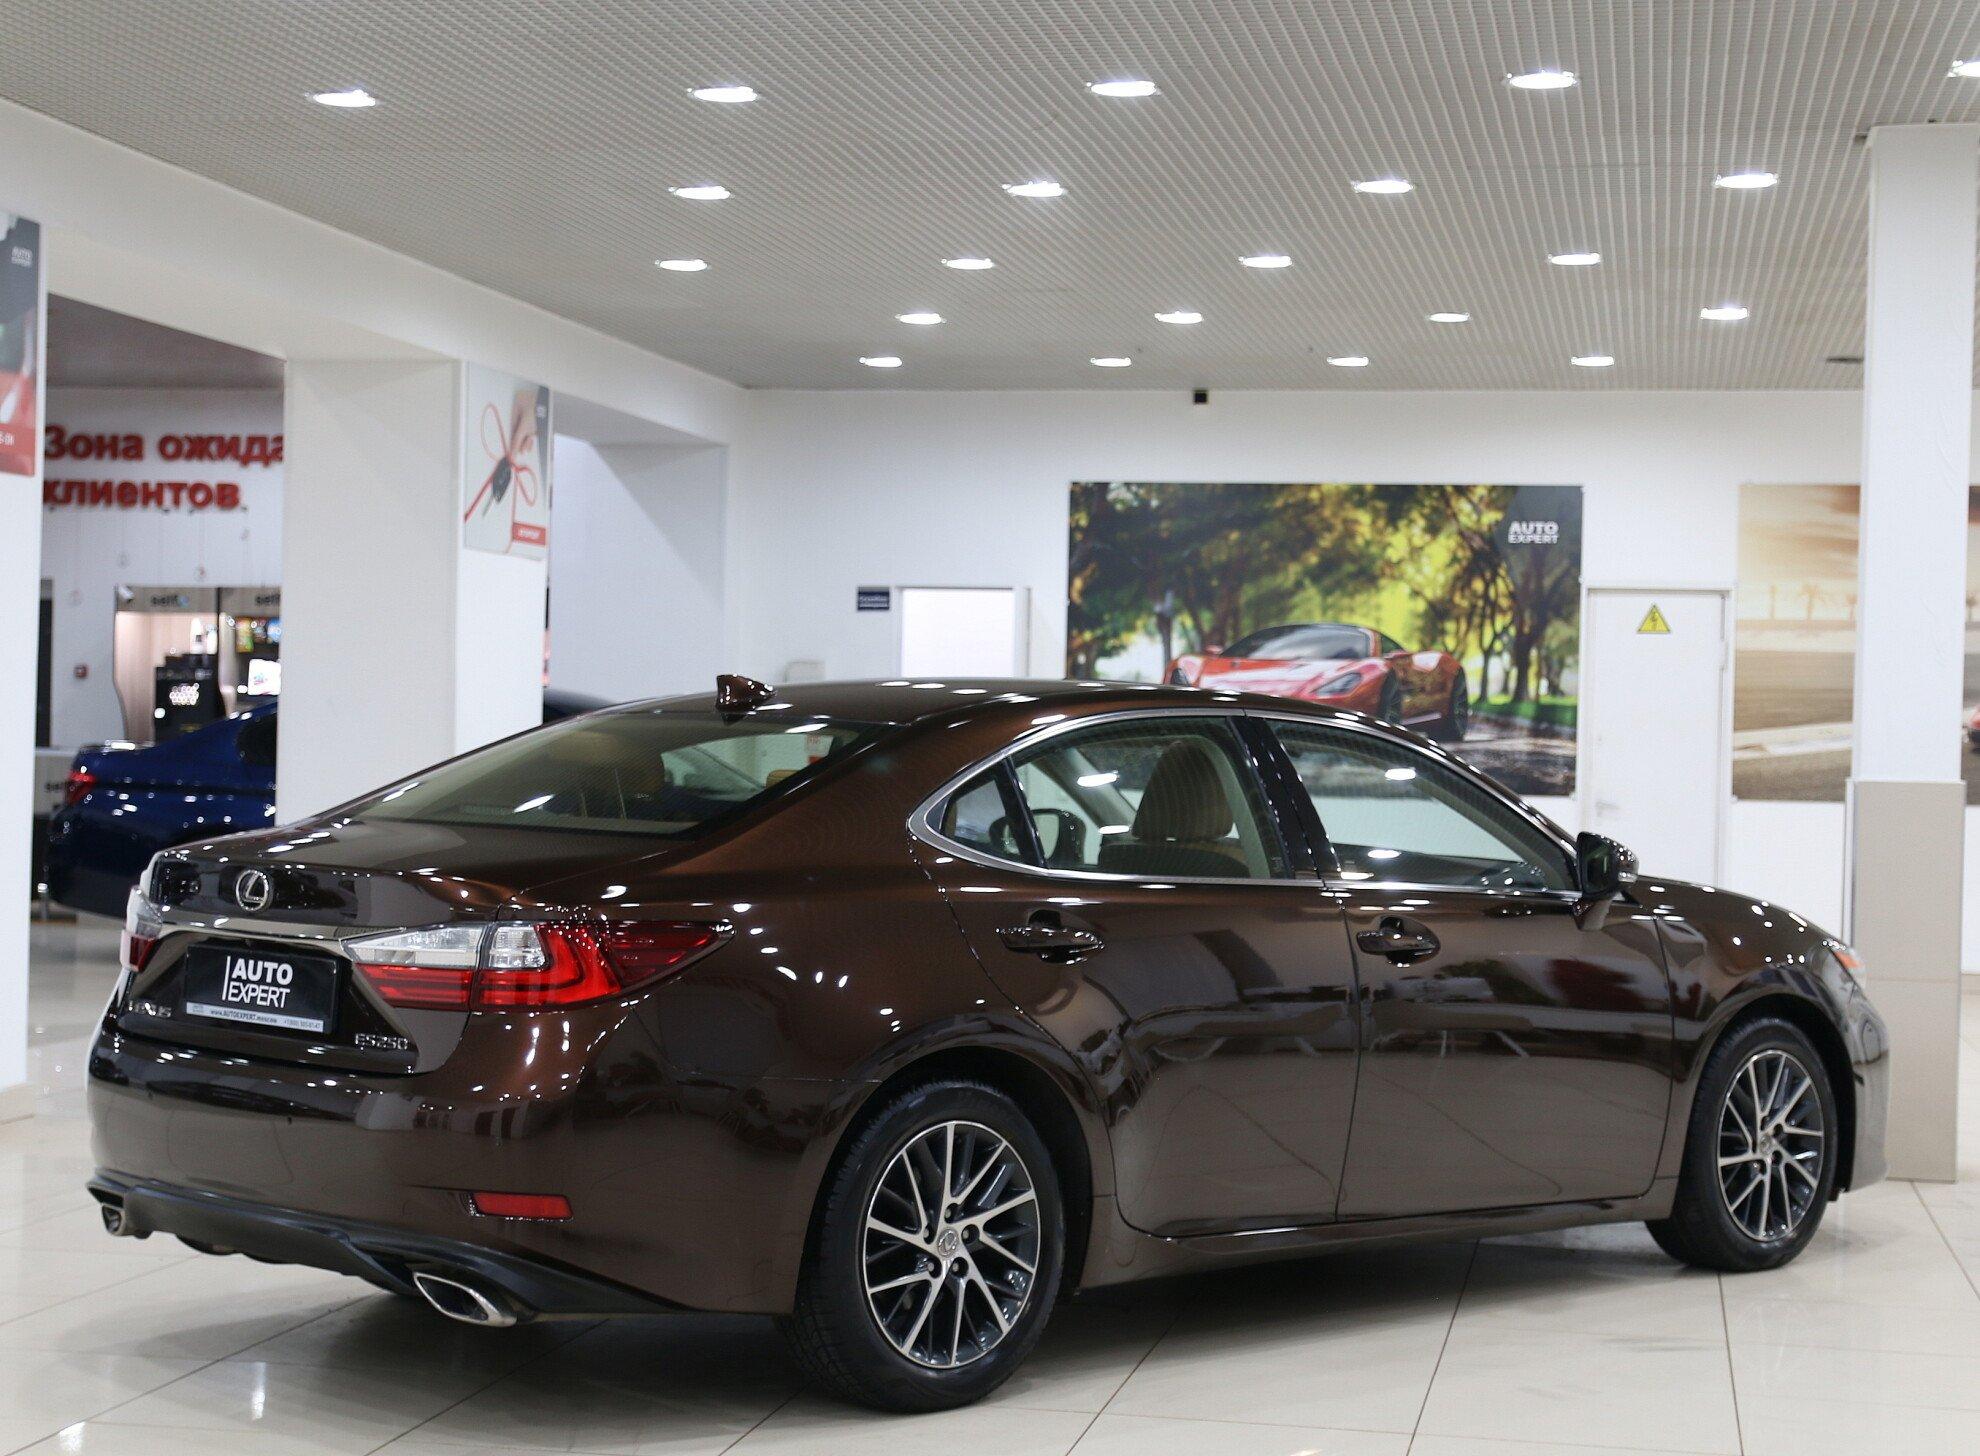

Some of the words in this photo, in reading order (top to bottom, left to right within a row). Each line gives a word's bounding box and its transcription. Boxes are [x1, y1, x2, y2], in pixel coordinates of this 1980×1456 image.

[45, 425, 144, 460] Зона
[43, 479, 240, 508] клиентов
[1508, 534, 1559, 544] EXPERT
[1509, 520, 1559, 535] AUTO
[231, 958, 293, 985] AUTO
[227, 981, 291, 1008] EXPERT
